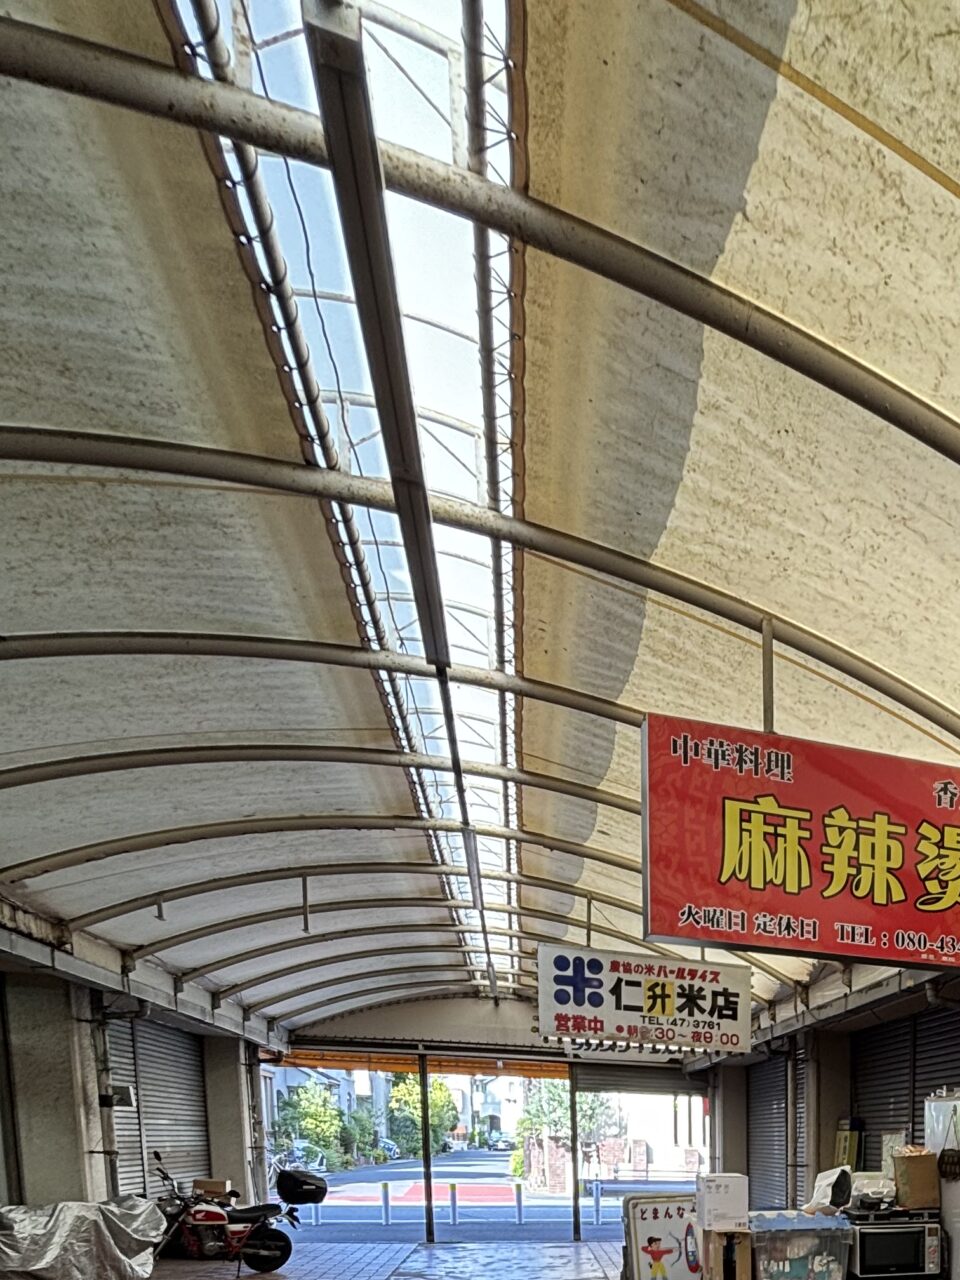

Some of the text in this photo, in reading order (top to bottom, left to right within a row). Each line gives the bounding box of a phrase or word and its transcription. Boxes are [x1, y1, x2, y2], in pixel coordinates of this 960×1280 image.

[671, 735, 794, 783] 中華料理
[678, 904, 747, 933] 火曜日
[753, 910, 819, 941] 定休日
[554, 1013, 604, 1034] 営業中
